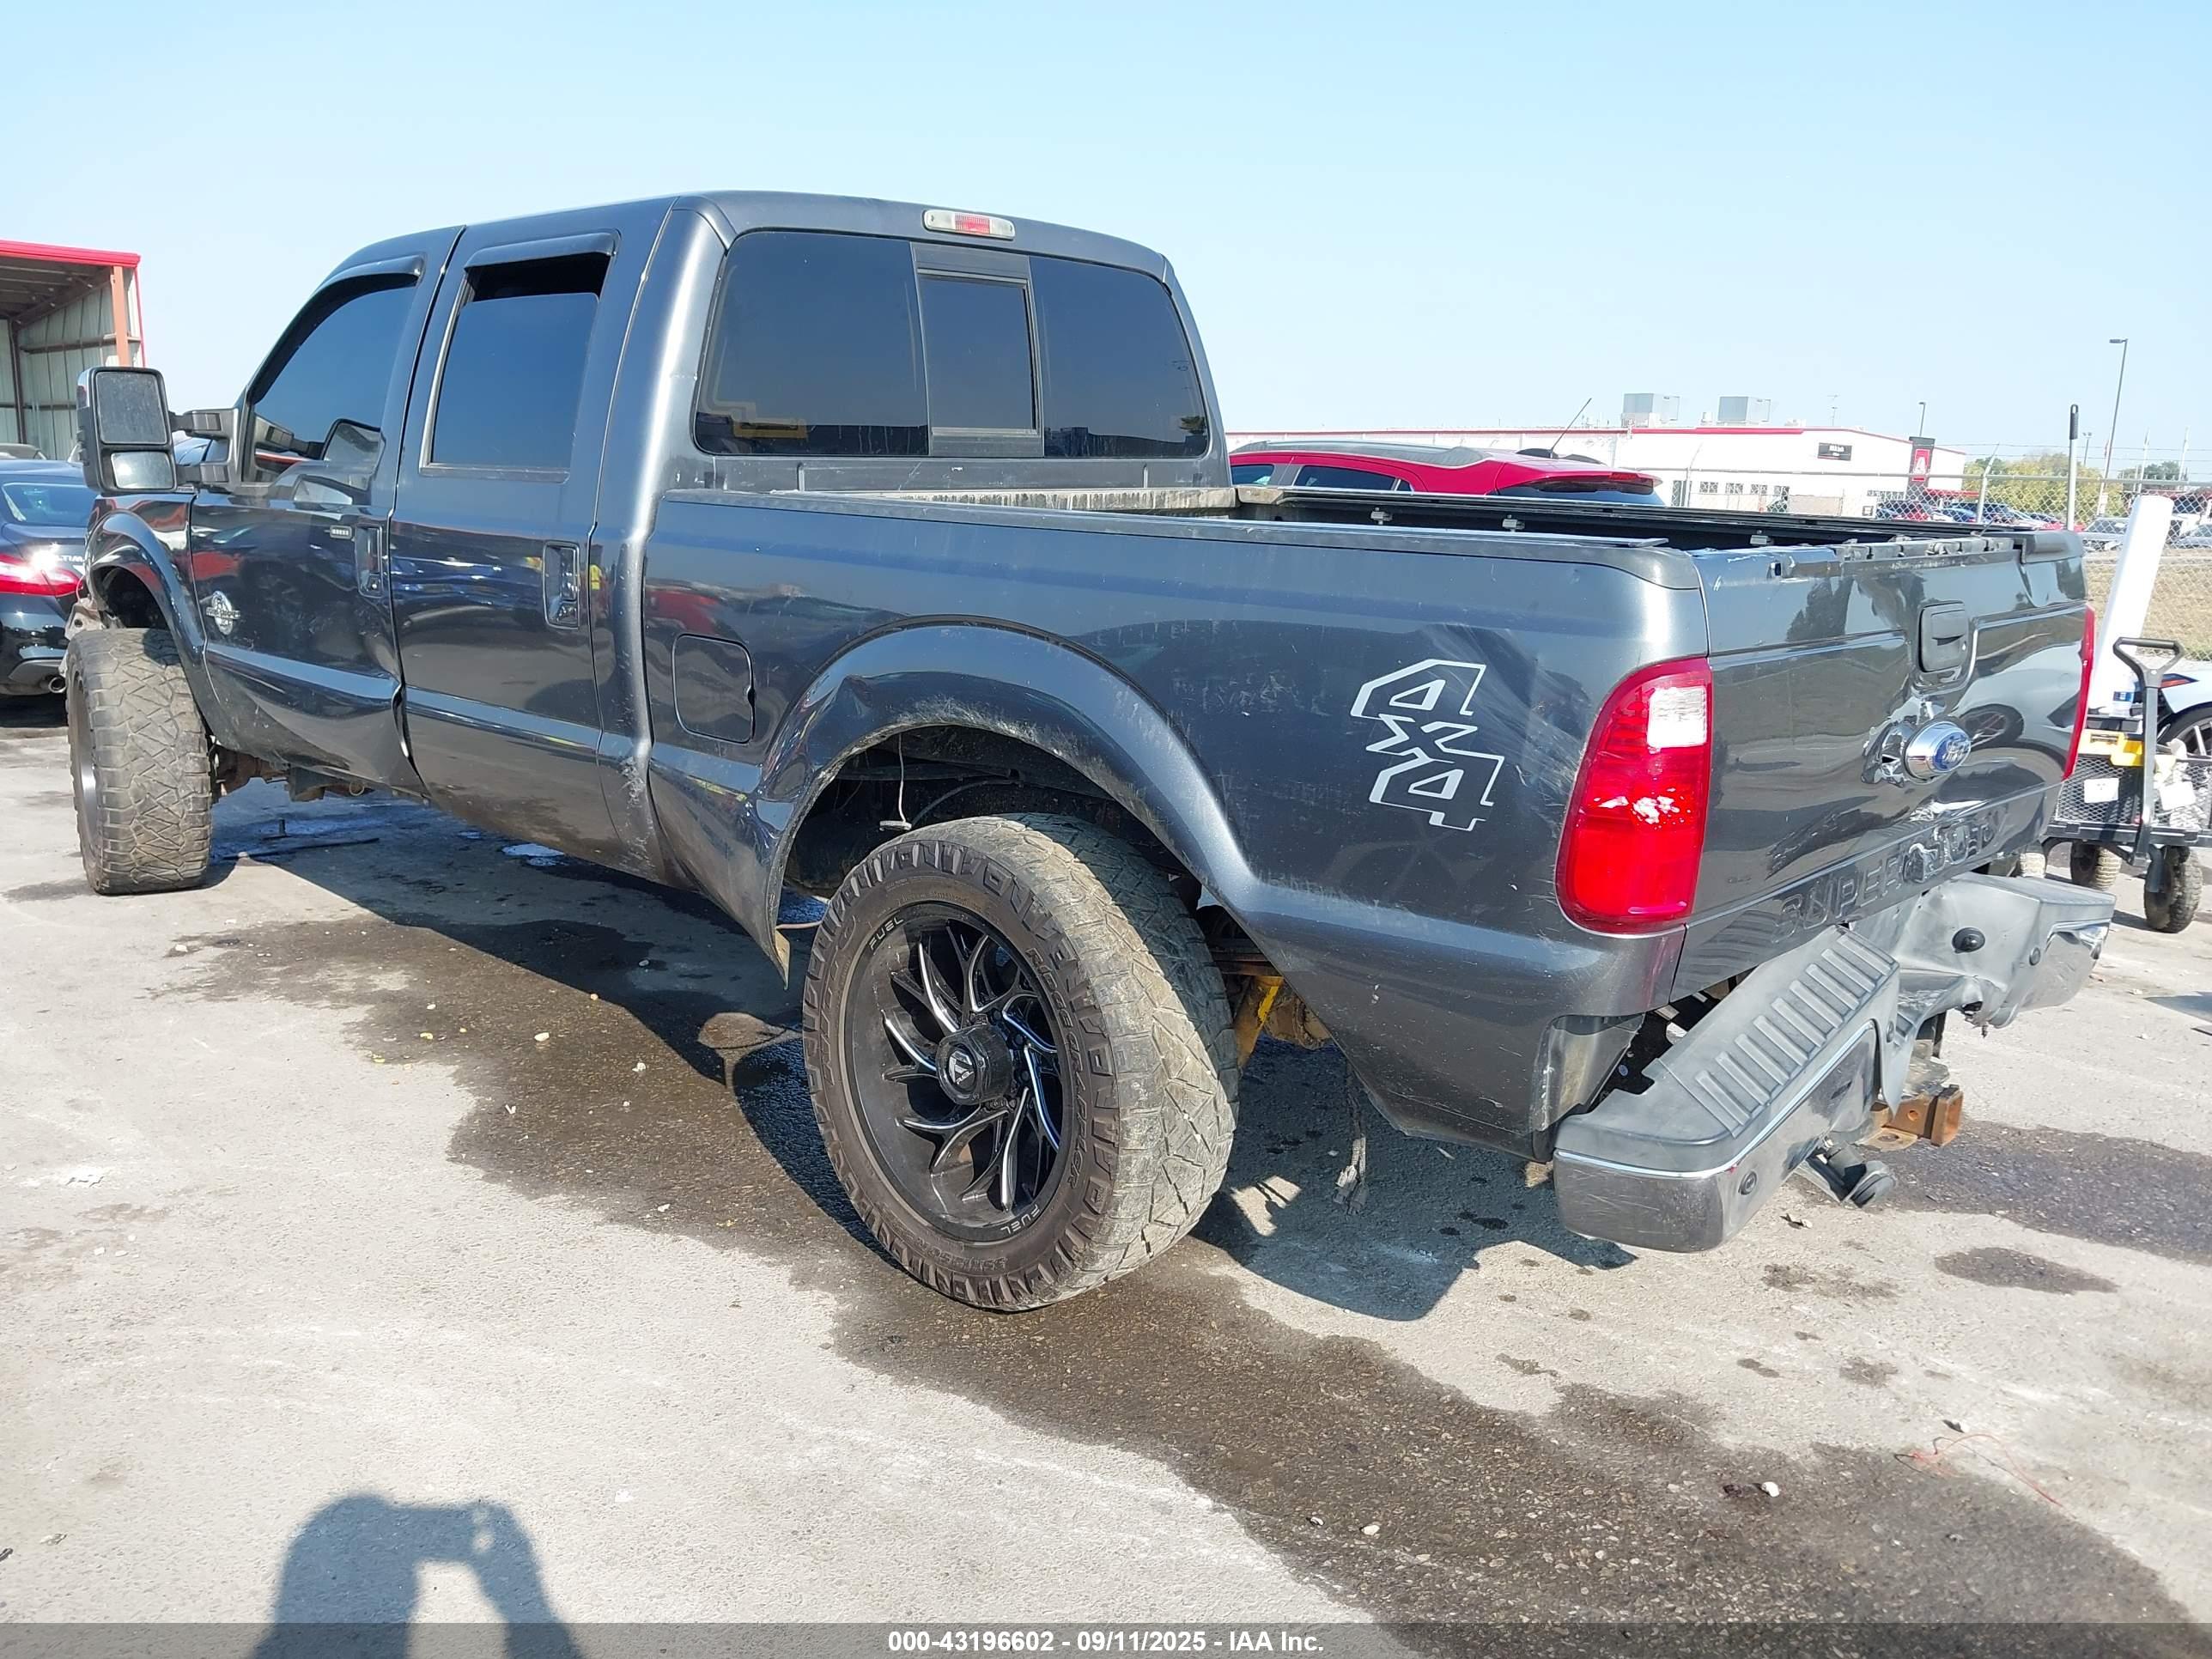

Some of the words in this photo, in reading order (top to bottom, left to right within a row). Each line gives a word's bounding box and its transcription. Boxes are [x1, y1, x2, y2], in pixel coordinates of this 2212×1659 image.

[869, 917, 904, 951] FUEL
[1028, 947, 1073, 1028] RIDGE
[1000, 1204, 1041, 1235] FUEL
